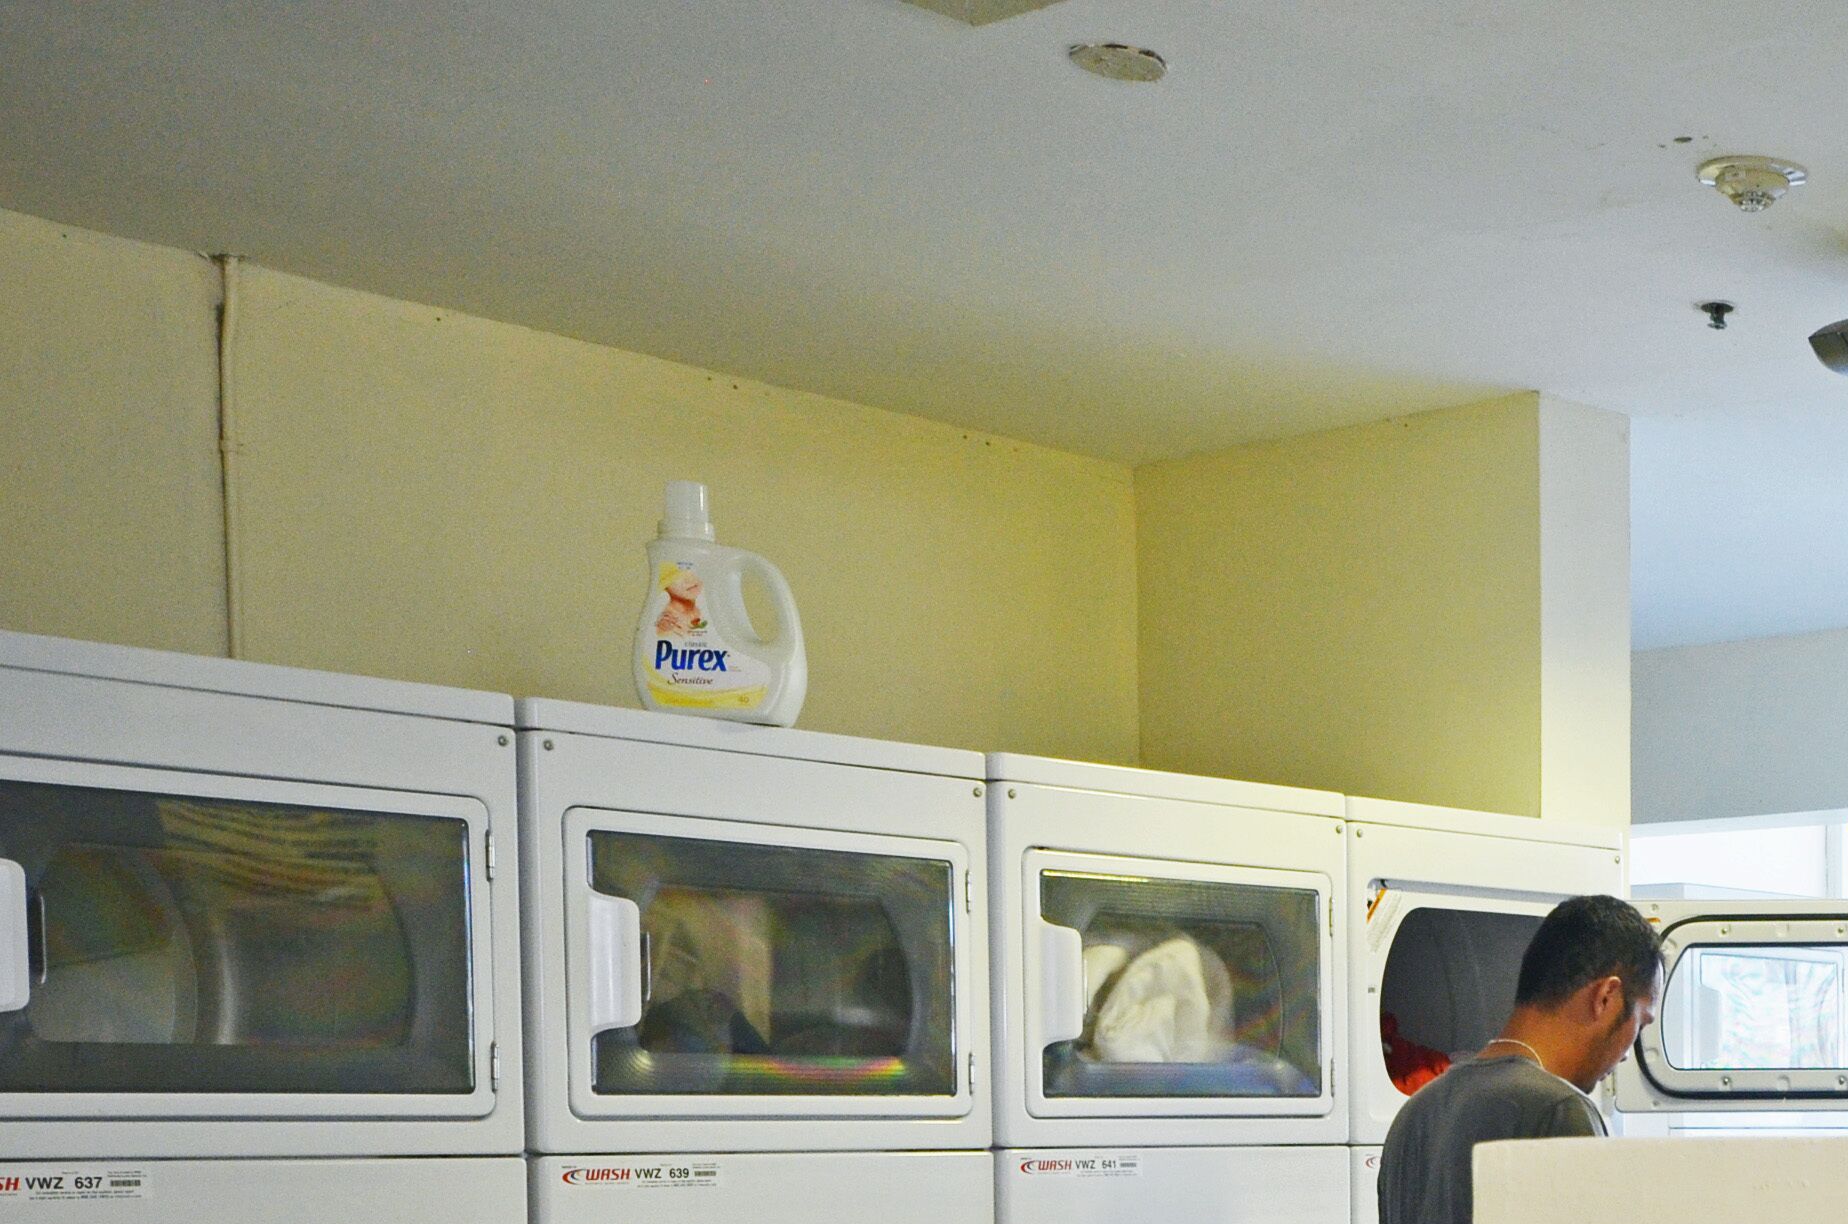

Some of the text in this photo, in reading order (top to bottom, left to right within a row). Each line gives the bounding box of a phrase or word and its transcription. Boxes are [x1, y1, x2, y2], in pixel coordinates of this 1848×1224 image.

[655, 639, 728, 672] Purex
[667, 672, 714, 686] Sensitive
[1038, 1160, 1072, 1171] WASH
[1075, 1160, 1096, 1169] VWZ
[585, 1168, 690, 1181] WASH VWZ 639
[25, 1176, 64, 1190] VWZ
[74, 1176, 103, 1190] 637
